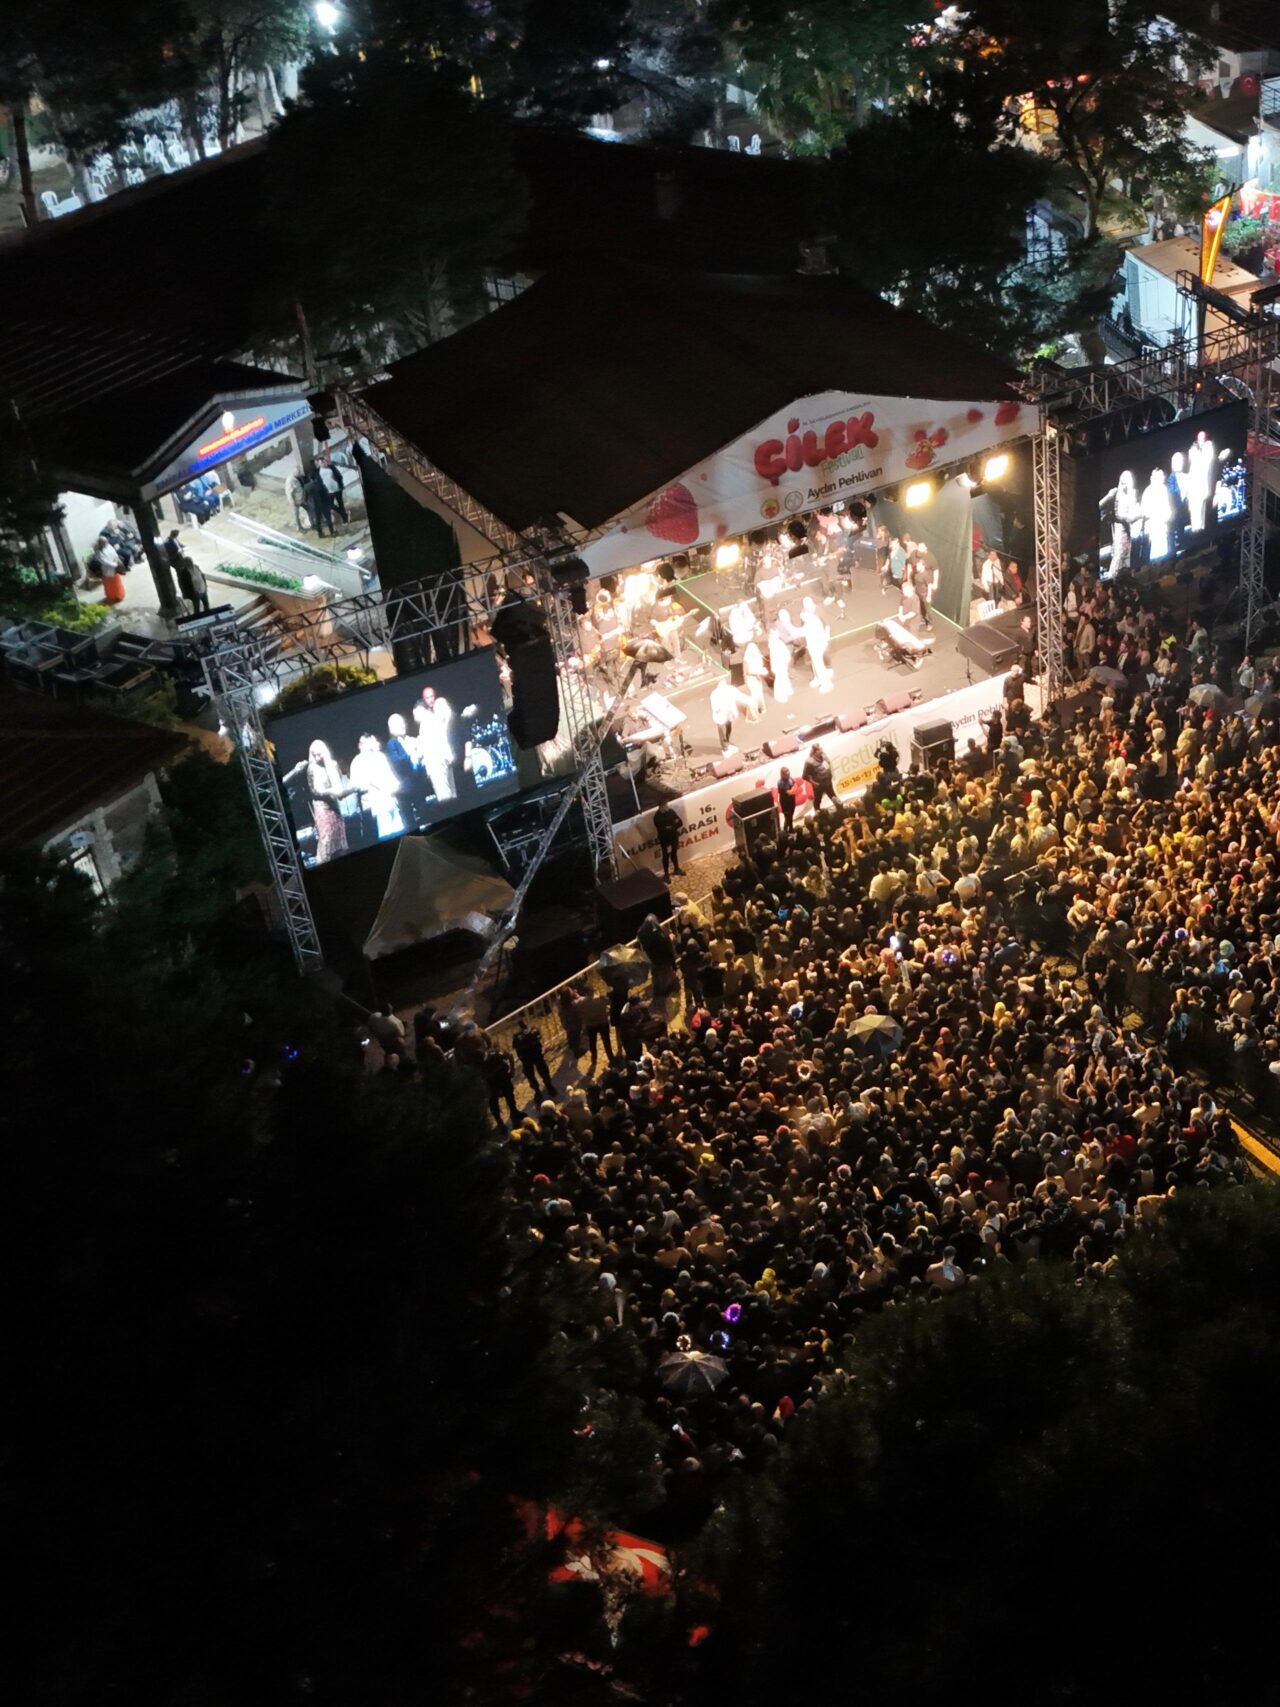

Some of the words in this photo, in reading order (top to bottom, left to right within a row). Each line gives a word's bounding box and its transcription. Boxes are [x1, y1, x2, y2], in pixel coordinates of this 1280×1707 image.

[754, 411, 879, 487] ÇİLEK
[807, 480, 837, 499] Aydın
[838, 467, 883, 488] Pehlivan
[699, 803, 717, 816] 16.
